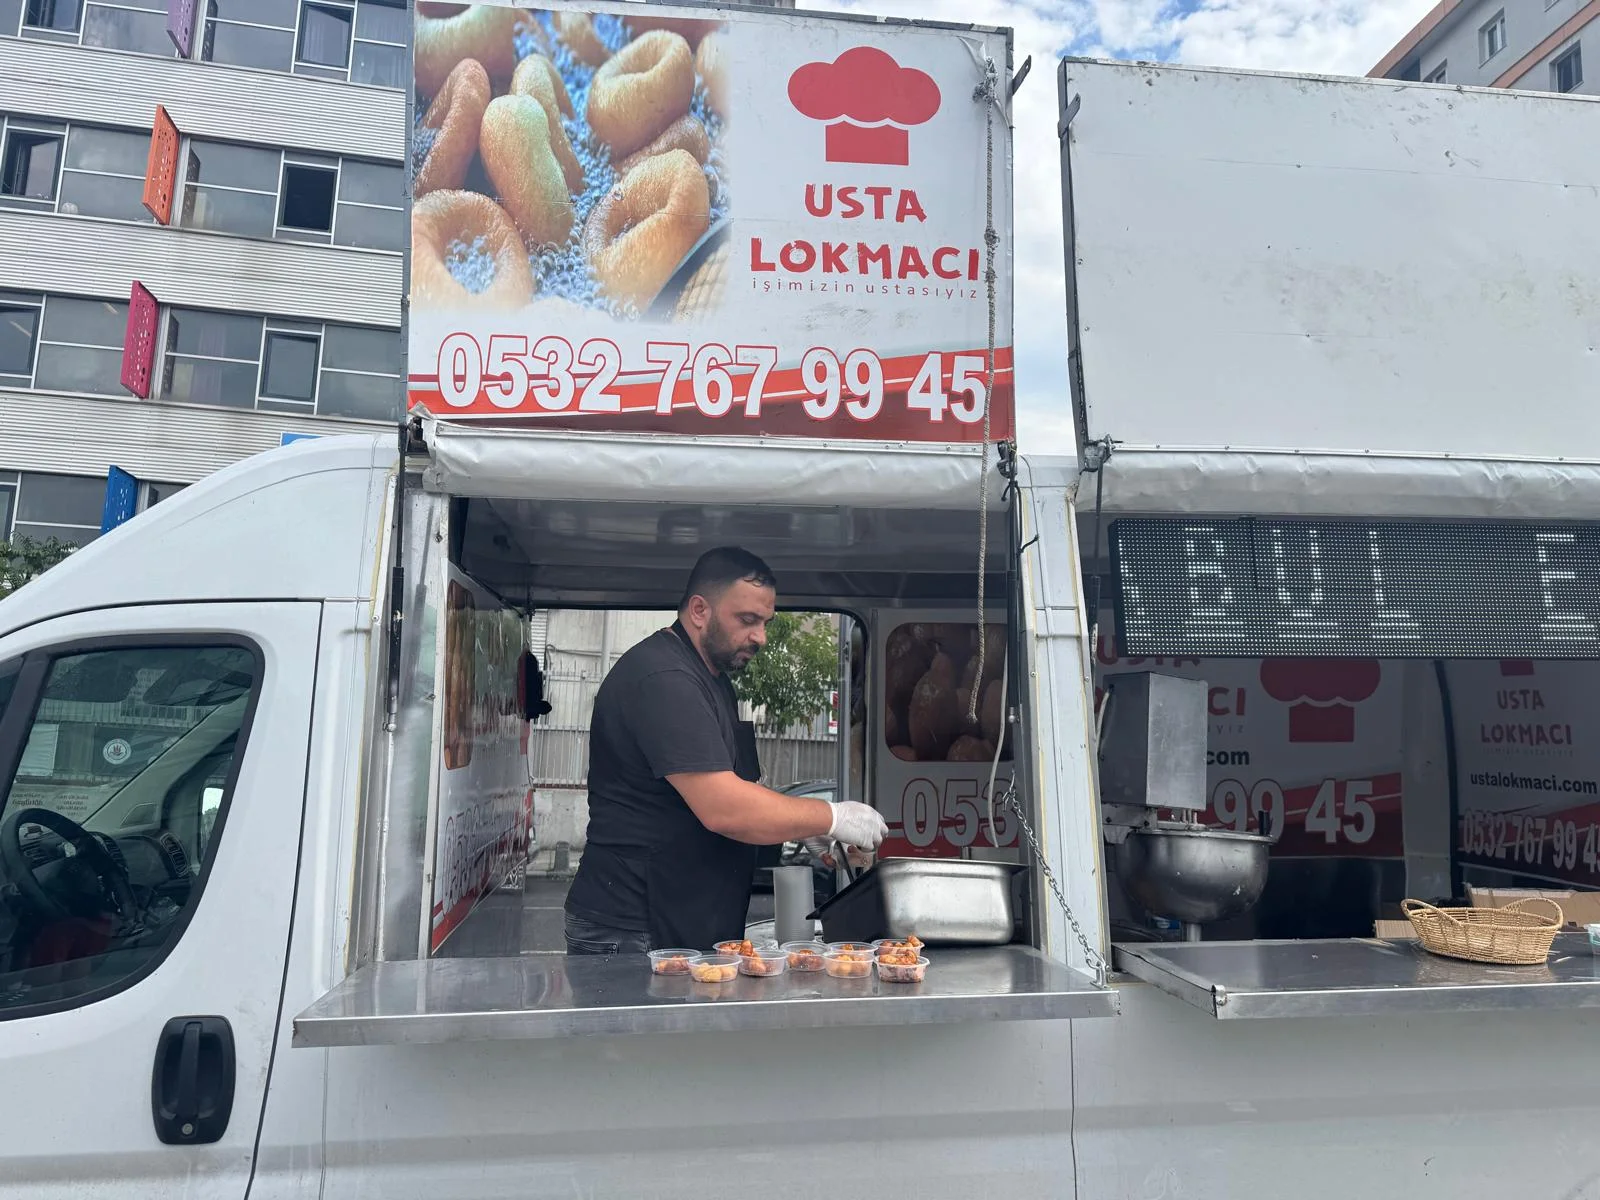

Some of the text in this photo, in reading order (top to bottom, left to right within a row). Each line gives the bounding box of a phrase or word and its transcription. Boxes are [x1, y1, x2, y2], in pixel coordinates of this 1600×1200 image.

[804, 183, 928, 223] USTA
[750, 237, 981, 281] LOKMACI
[752, 277, 978, 300] işimizin ustasıyız
[437, 331, 988, 424] 0532 767 99 45
[1496, 688, 1546, 711] USTA
[1480, 722, 1573, 747] LOKMACI
[1469, 771, 1598, 794] ustalokmaci.com
[901, 777, 1019, 848] 053
[1304, 777, 1376, 844] 45
[1463, 807, 1600, 873] 0532 767 99 4
